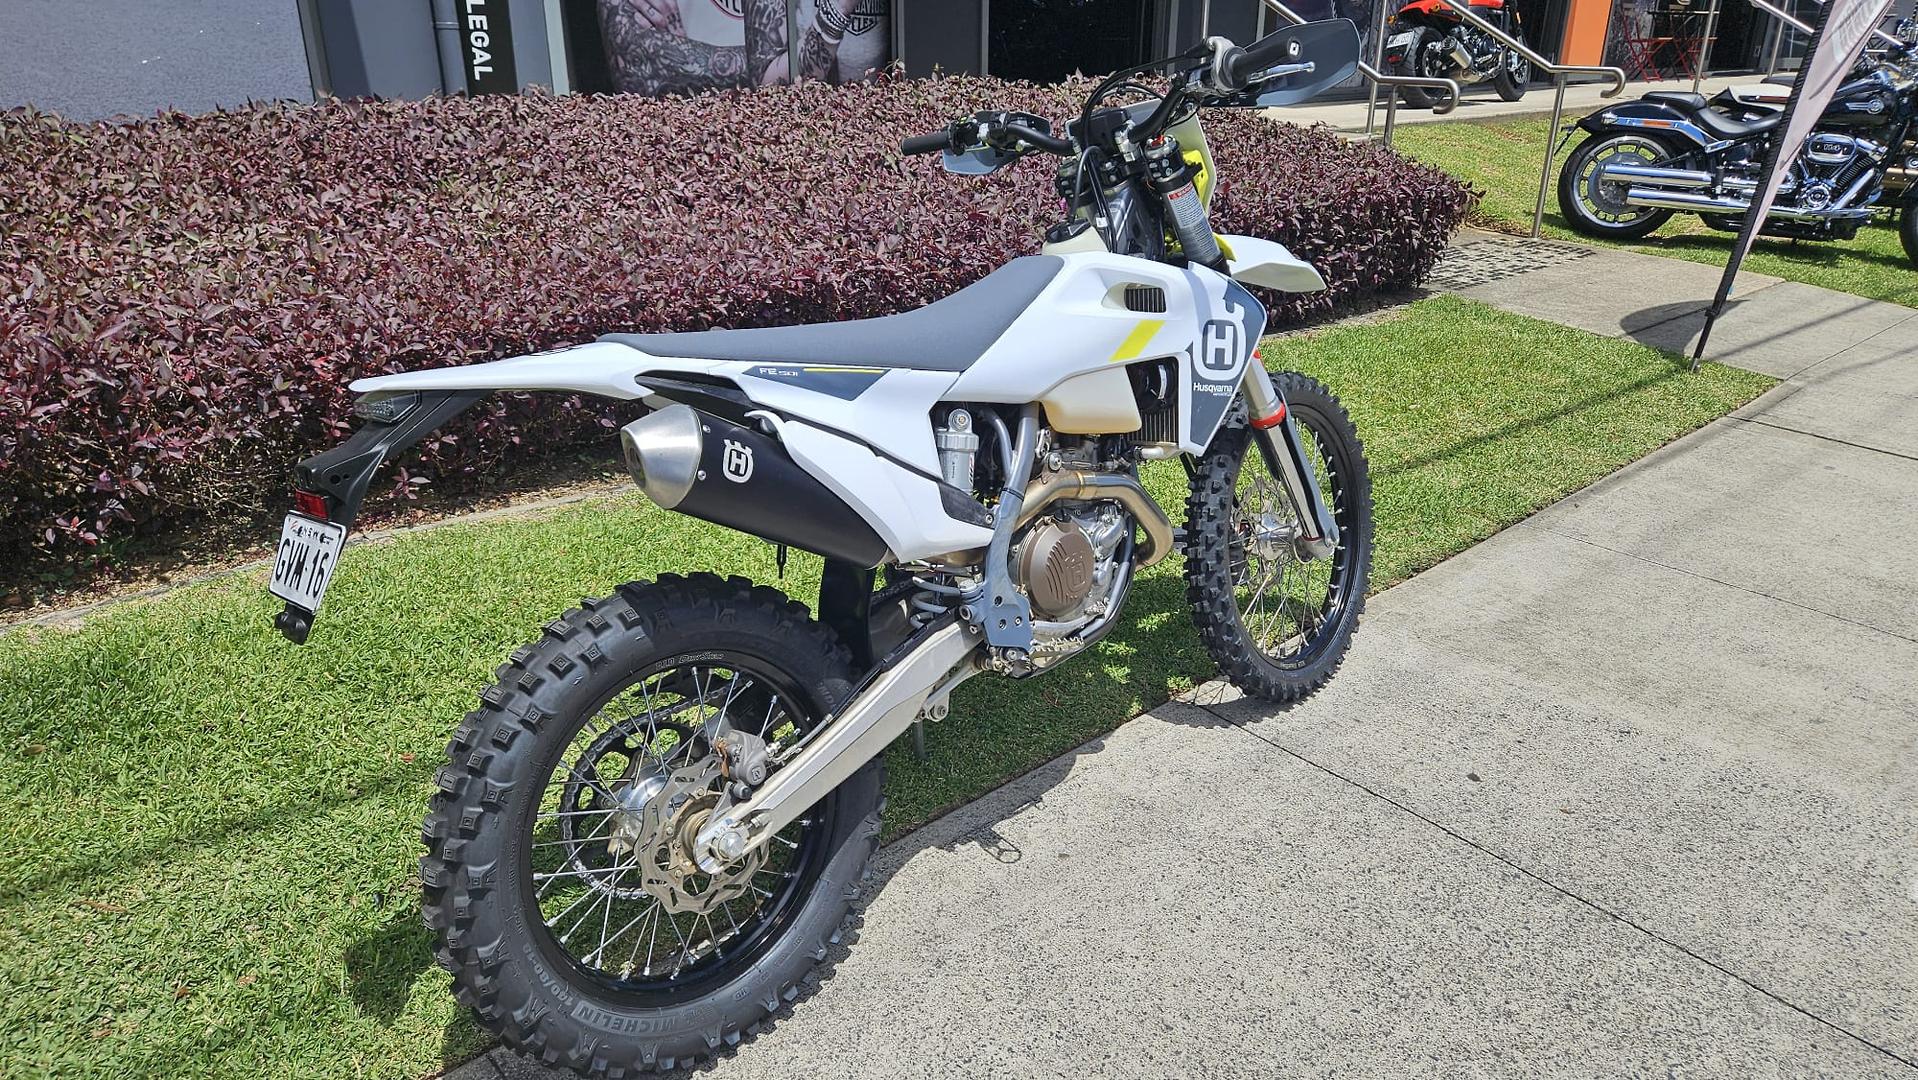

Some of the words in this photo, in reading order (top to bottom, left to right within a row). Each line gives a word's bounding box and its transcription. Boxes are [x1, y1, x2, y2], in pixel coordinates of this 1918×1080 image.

[465, 0, 493, 81] LEGAL
[1193, 382, 1233, 394] Husqvarna
[577, 1005, 676, 1033] MICHELIN
